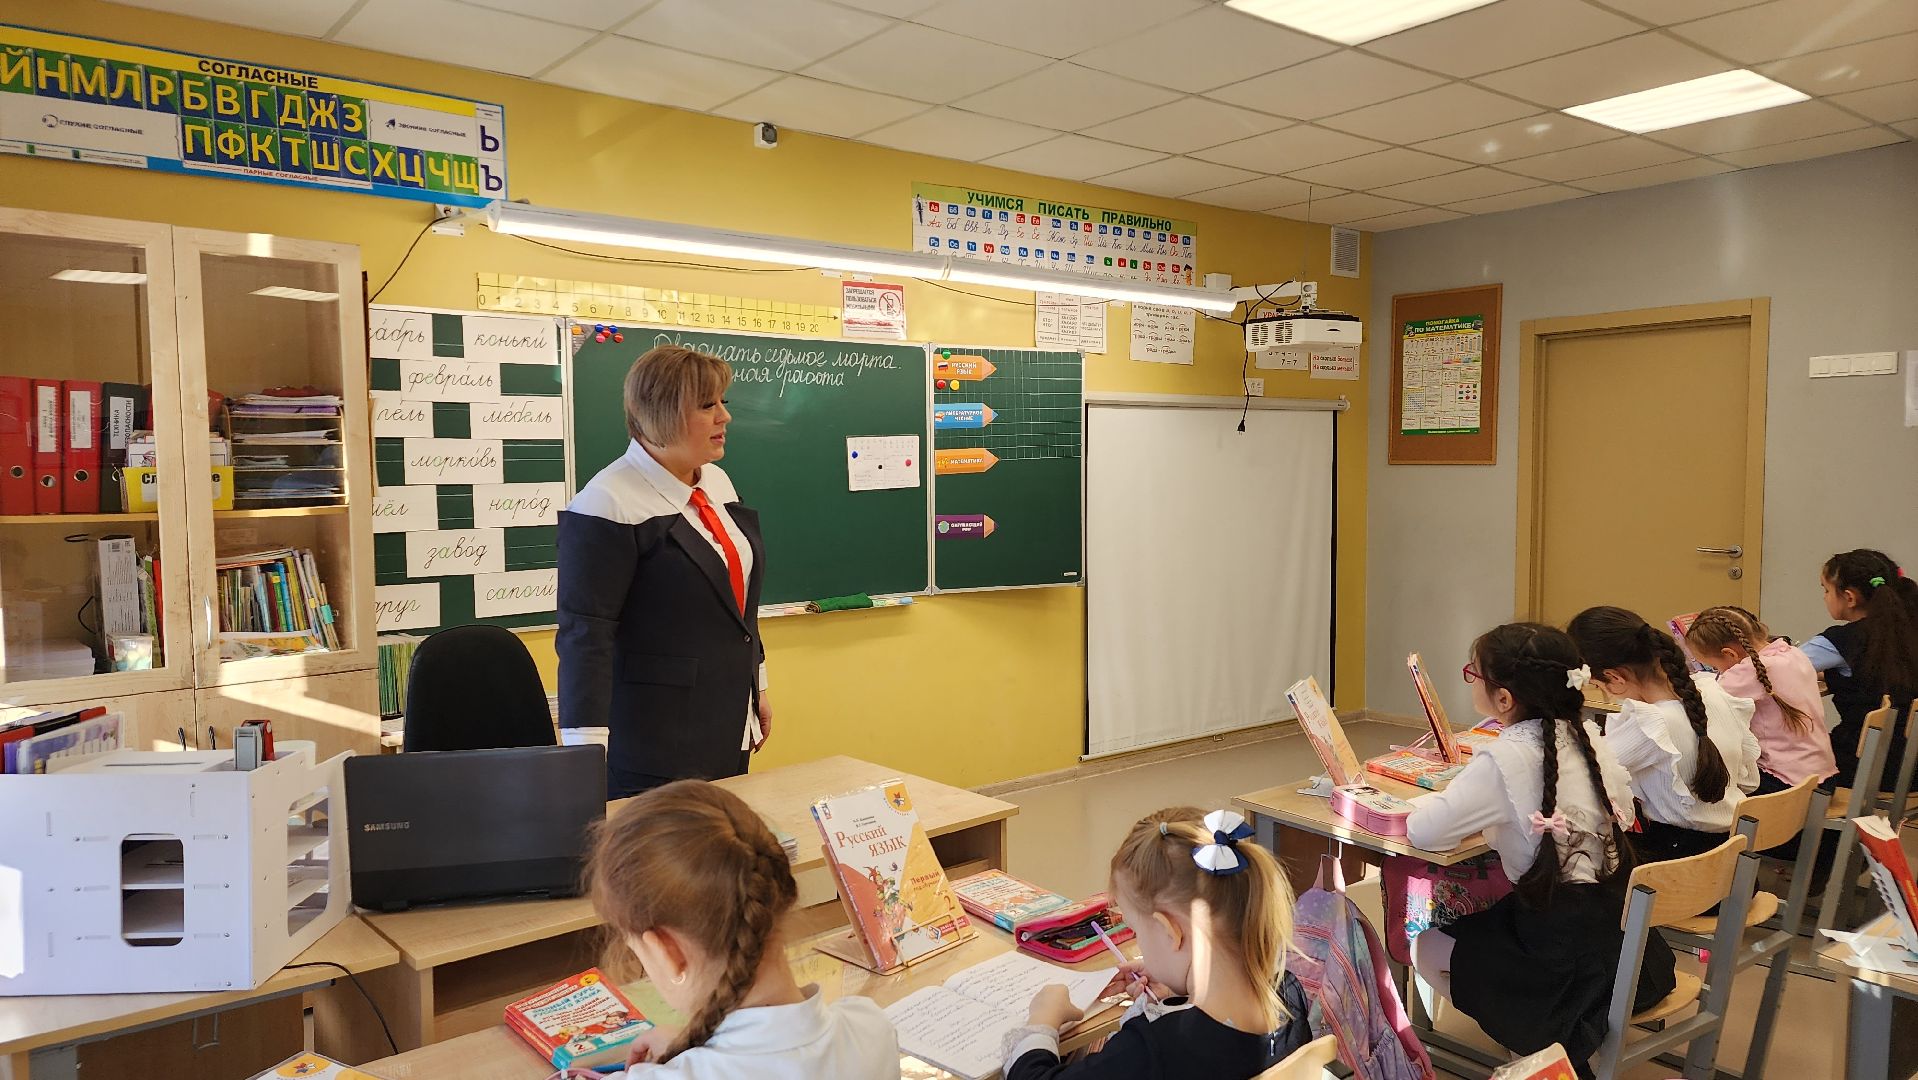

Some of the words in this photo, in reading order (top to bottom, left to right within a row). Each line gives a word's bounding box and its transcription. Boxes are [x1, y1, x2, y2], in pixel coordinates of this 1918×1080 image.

[198, 60, 319, 89] СОГЛАСНЫЕ
[480, 125, 500, 152] Ь
[480, 164, 502, 191] Ъ
[967, 192, 1024, 211] УЧИМСЯ
[1038, 202, 1089, 220] ПИСАТЬ
[1102, 211, 1171, 231] ПРАВИЛЬНО
[479, 294, 485, 305] 0
[496, 296, 500, 305] 1
[515, 298, 522, 308] 2
[535, 300, 540, 308] 3
[552, 301, 559, 310] 4
[572, 303, 578, 312] 5
[590, 305, 596, 313] 6
[608, 305, 614, 315] 7
[625, 307, 631, 316] 8
[642, 308, 648, 317] 9
[657, 310, 667, 319] 10
[691, 313, 700, 322] 12
[707, 314, 715, 323] 13
[722, 316, 731, 324] 14
[737, 317, 746, 326] 15
[753, 318, 762, 328] 16
[768, 320, 776, 329] 17
[782, 321, 791, 330] 18
[796, 322, 805, 331] 19
[810, 323, 819, 333] 20
[730, 366, 774, 383] ная
[364, 822, 410, 832] SAMSUNG
[835, 824, 888, 848] Русский
[910, 871, 940, 885] Первый
[944, 895, 955, 911] 2
